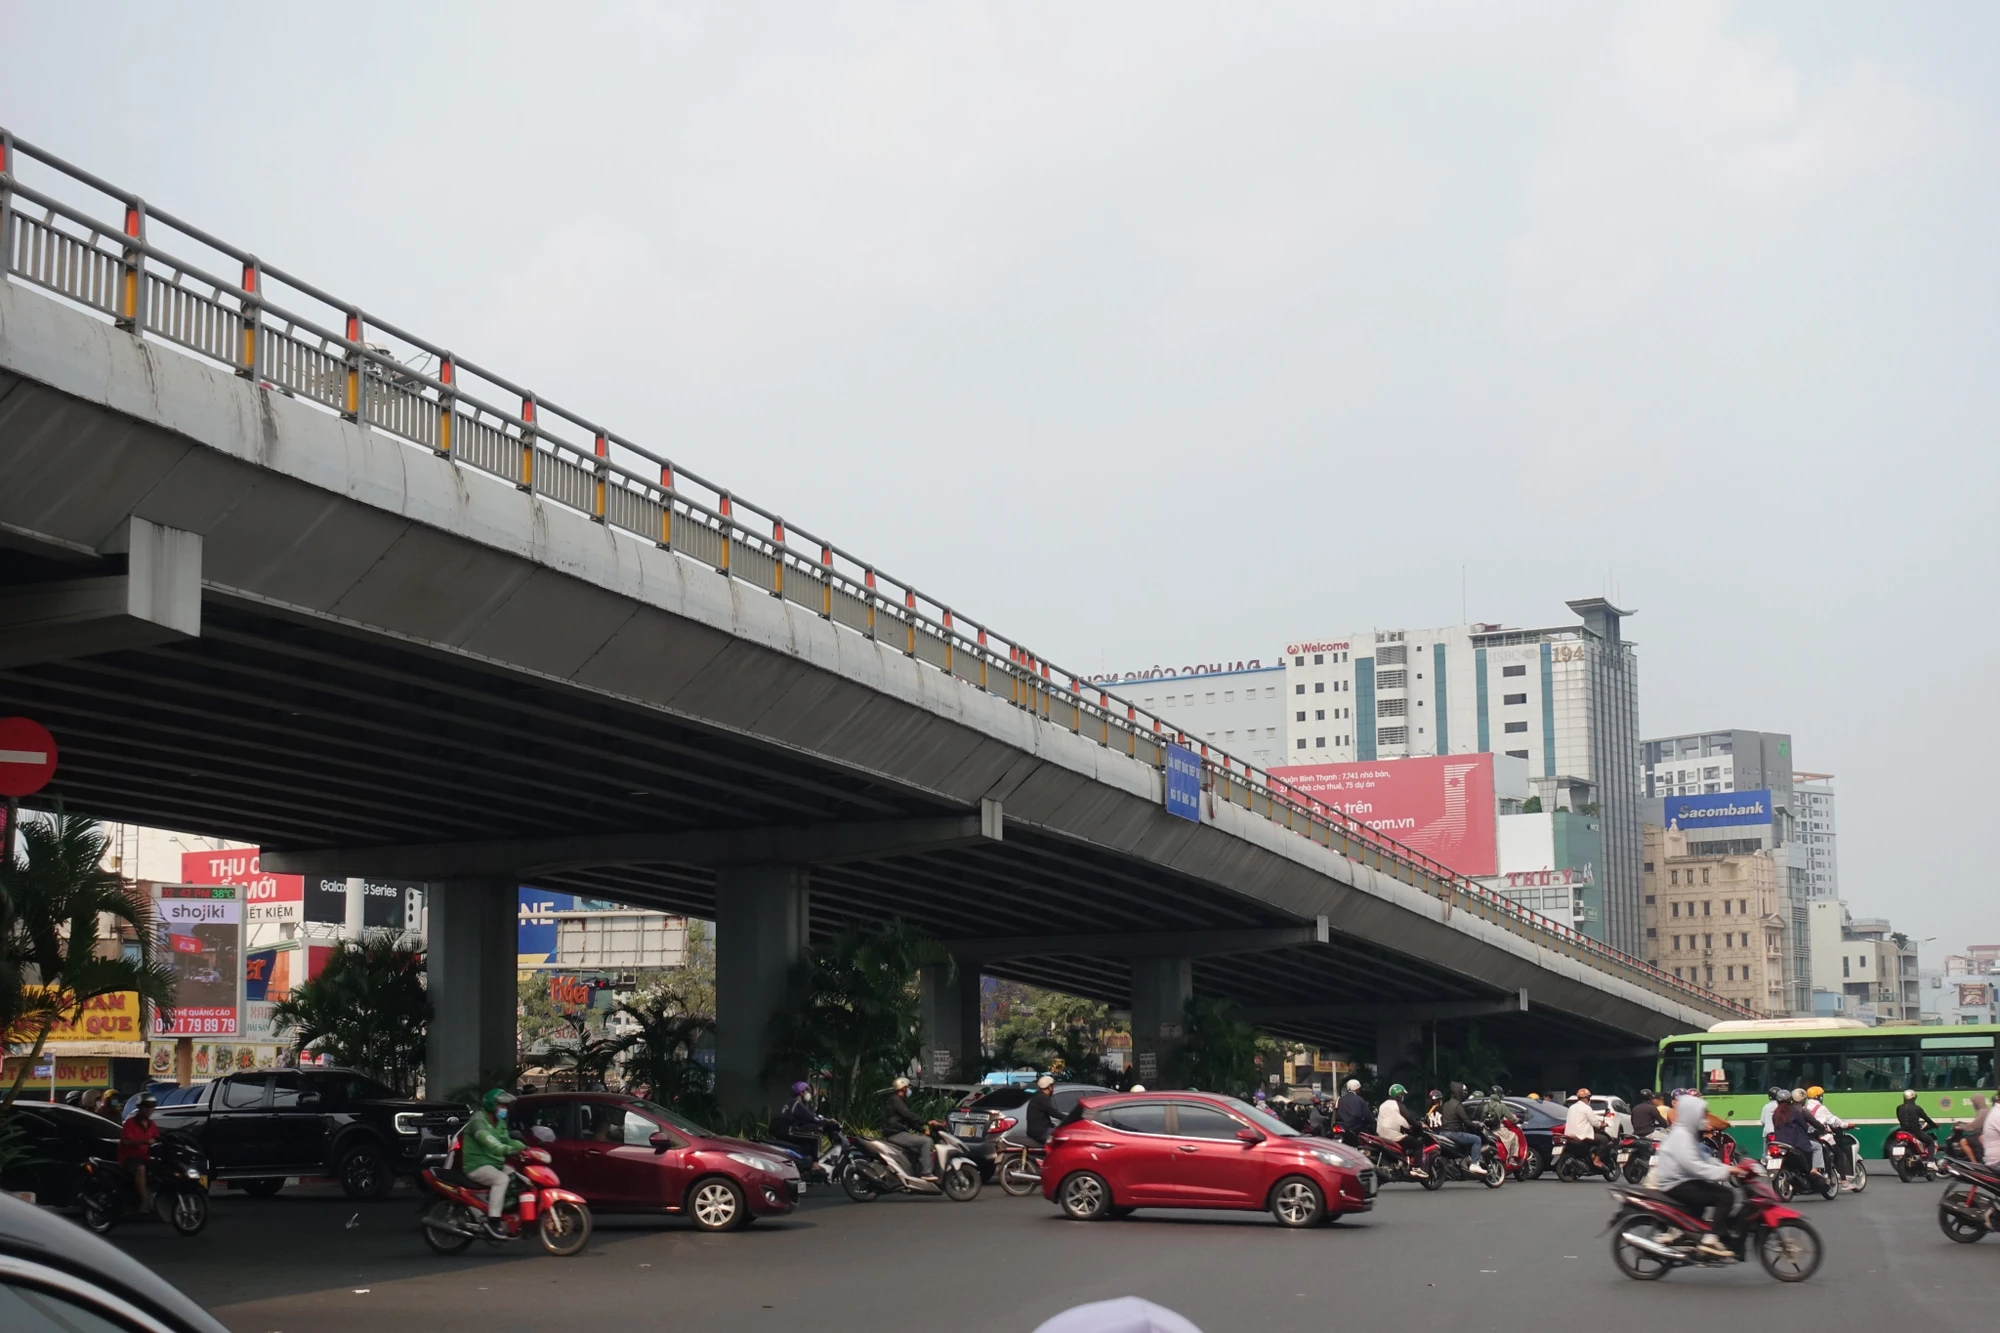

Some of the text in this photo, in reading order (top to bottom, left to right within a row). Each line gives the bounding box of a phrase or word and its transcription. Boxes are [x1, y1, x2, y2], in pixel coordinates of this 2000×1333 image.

[1301, 642, 1350, 654] Welcome
[1551, 645, 1585, 662] 194
[1313, 783, 1325, 791] cho
[1344, 800, 1373, 814] trên
[1678, 801, 1764, 819] Sacombank
[209, 857, 246, 877] THU
[320, 879, 347, 893] Galax
[370, 884, 398, 898] Series
[172, 904, 225, 921] shojiki
[266, 904, 293, 920] KIỆM
[86, 1015, 133, 1035] QUE
